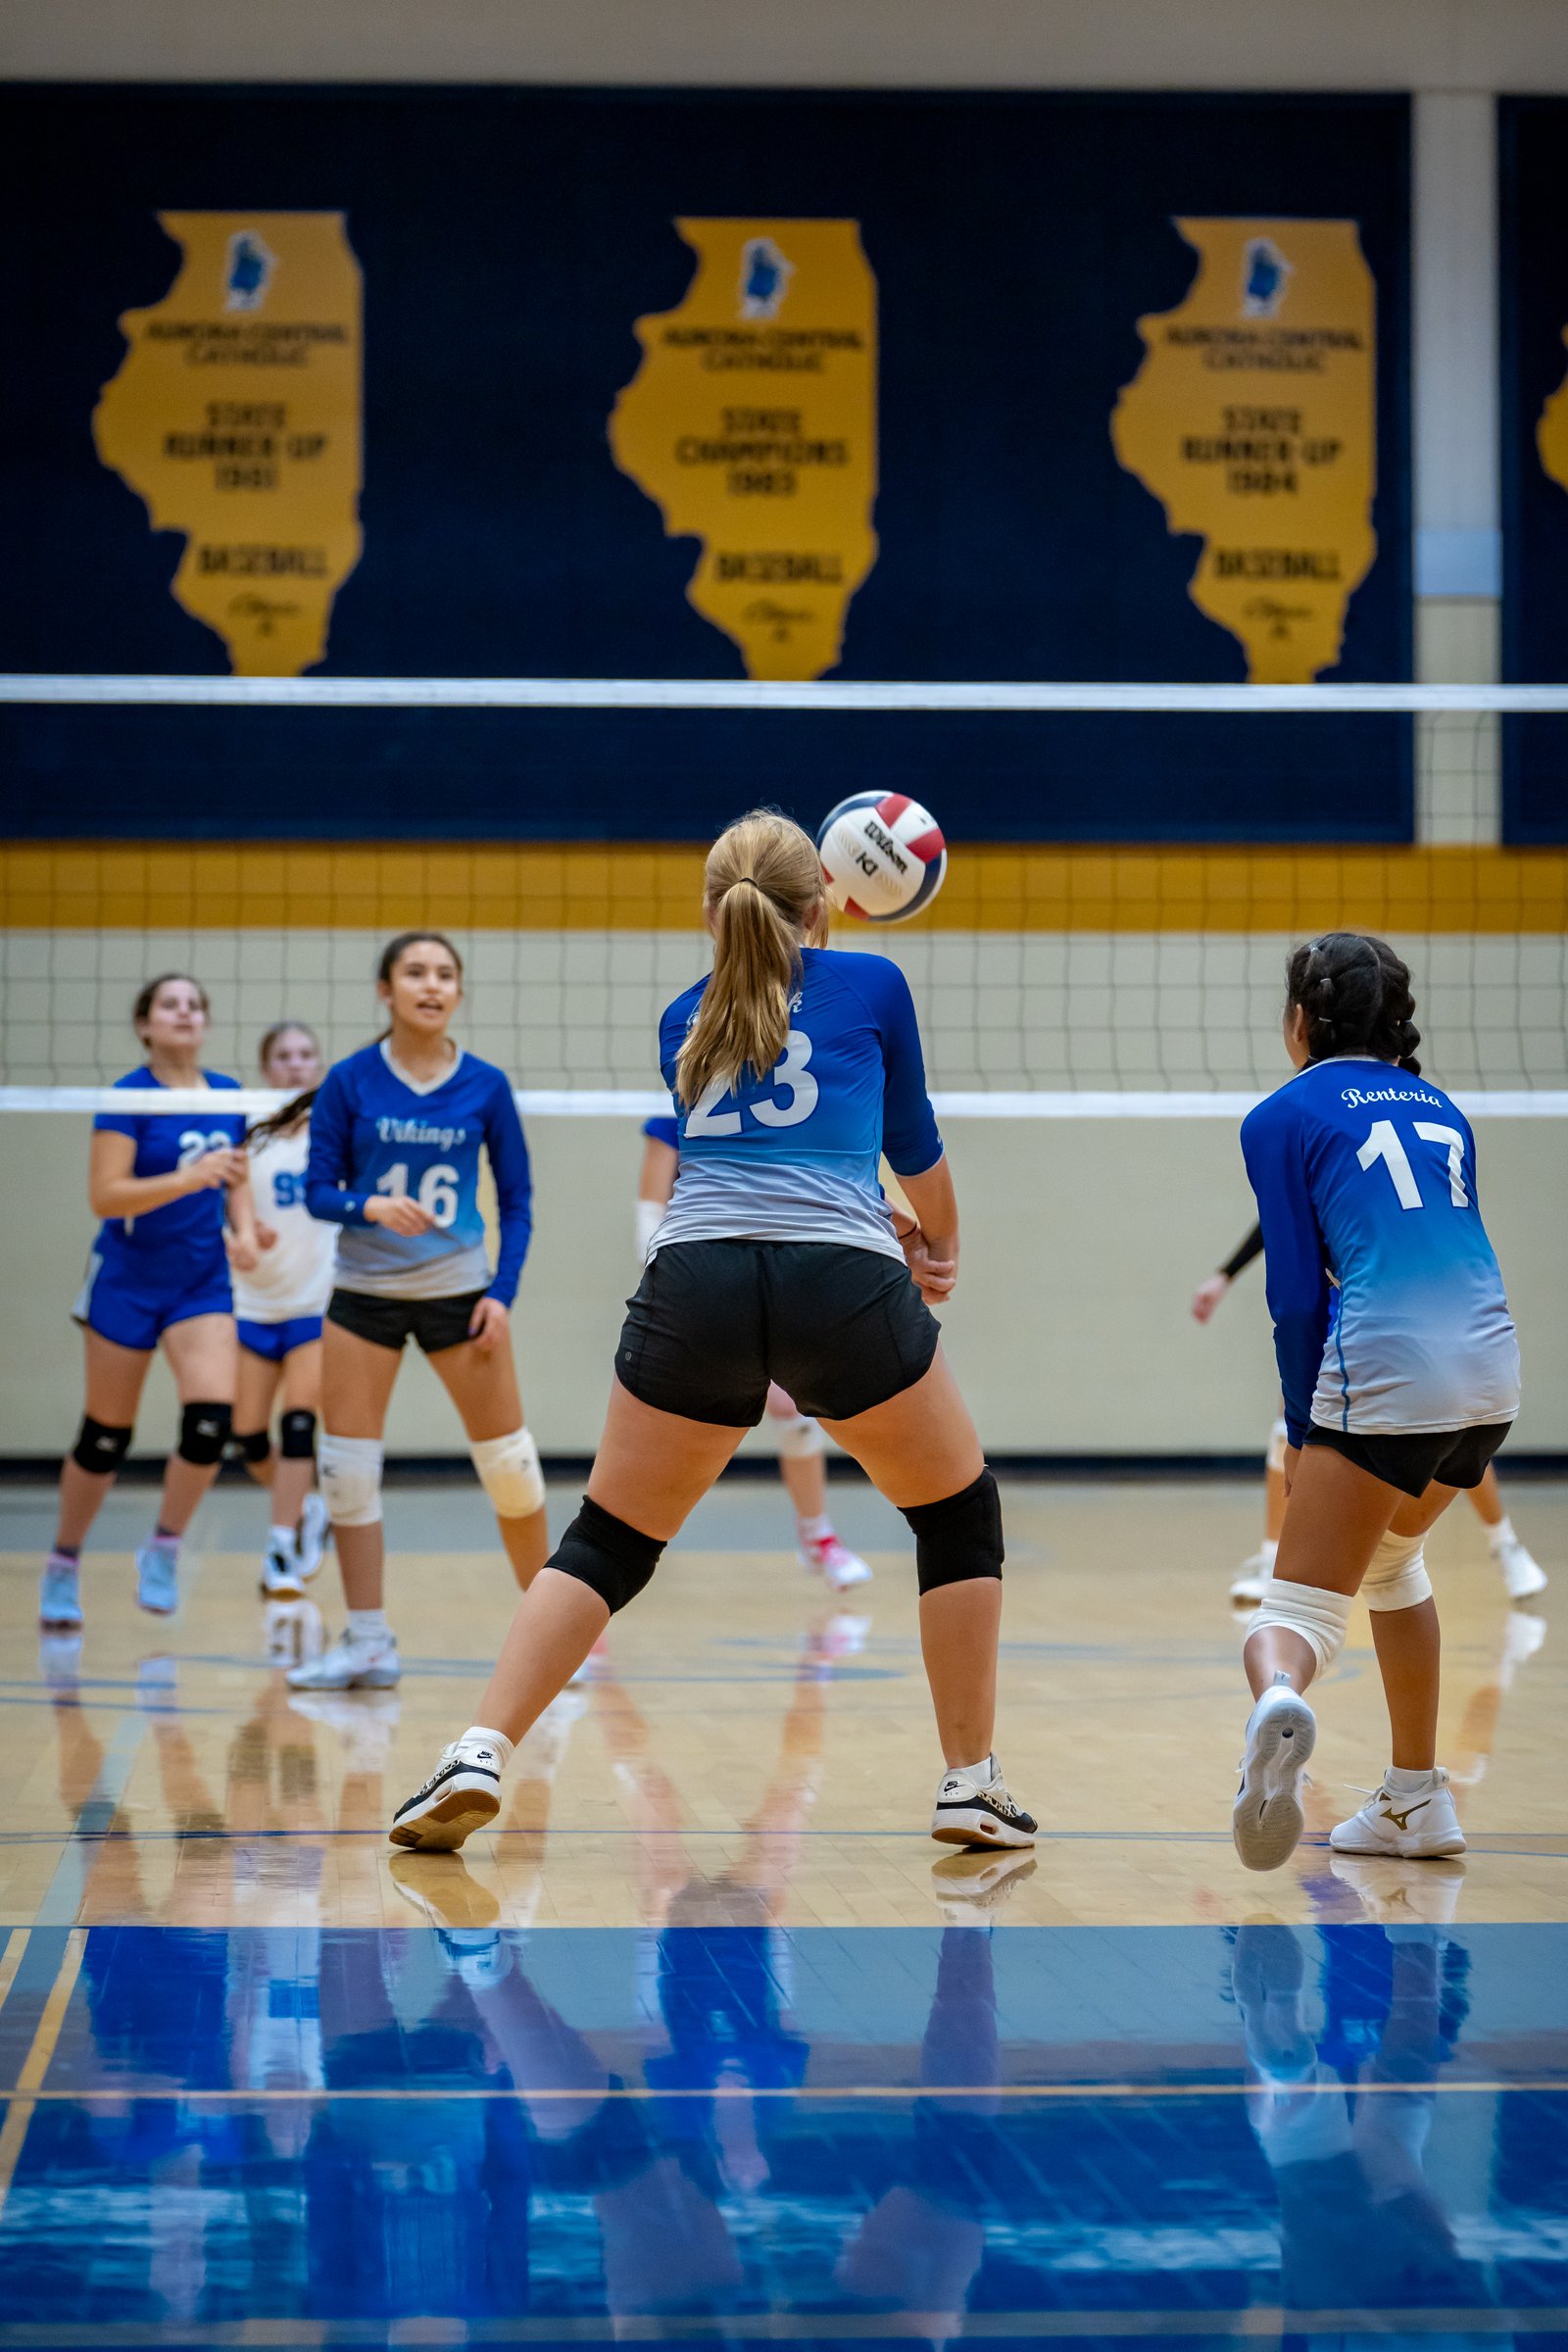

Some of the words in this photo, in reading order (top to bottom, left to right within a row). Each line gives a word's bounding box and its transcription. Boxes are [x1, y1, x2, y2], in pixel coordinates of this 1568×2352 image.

[207, 403, 286, 427] STATE
[723, 409, 802, 432] STATE
[1224, 407, 1301, 432] STATE
[165, 433, 274, 460] RUNNER
[676, 439, 849, 466] CHAMPIONS
[1182, 437, 1290, 464] RUNNER
[200, 546, 327, 576] BASEBALL
[716, 554, 843, 582] BASEBALL
[1213, 550, 1341, 581] BASEBALL
[1341, 1087, 1443, 1109] Renteria
[375, 1116, 466, 1152] Vikings
[1355, 1119, 1469, 1210] 17
[376, 1162, 460, 1229] 16
